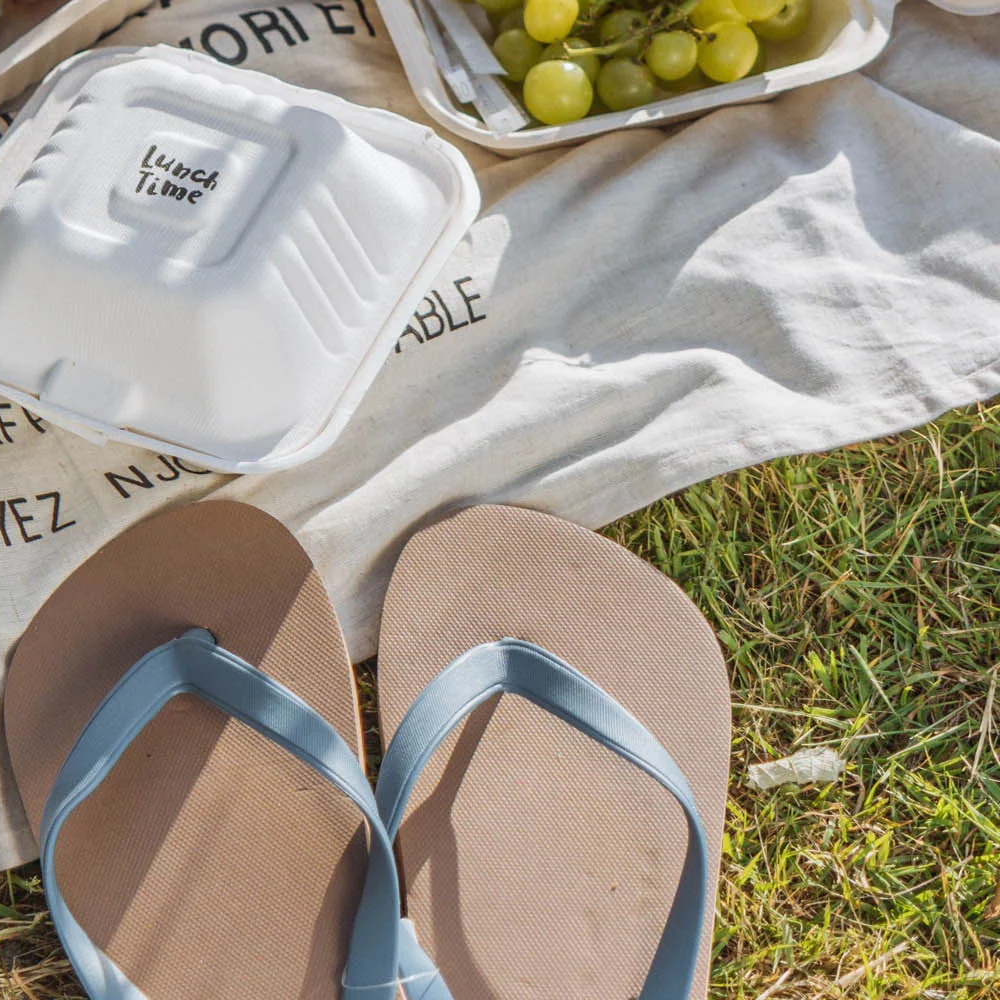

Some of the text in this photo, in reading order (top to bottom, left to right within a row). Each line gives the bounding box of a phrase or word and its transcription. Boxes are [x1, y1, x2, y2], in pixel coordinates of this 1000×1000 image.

[179, 5, 309, 66] ORI
[135, 170, 203, 204] Time
[141, 144, 219, 191] Lunch
